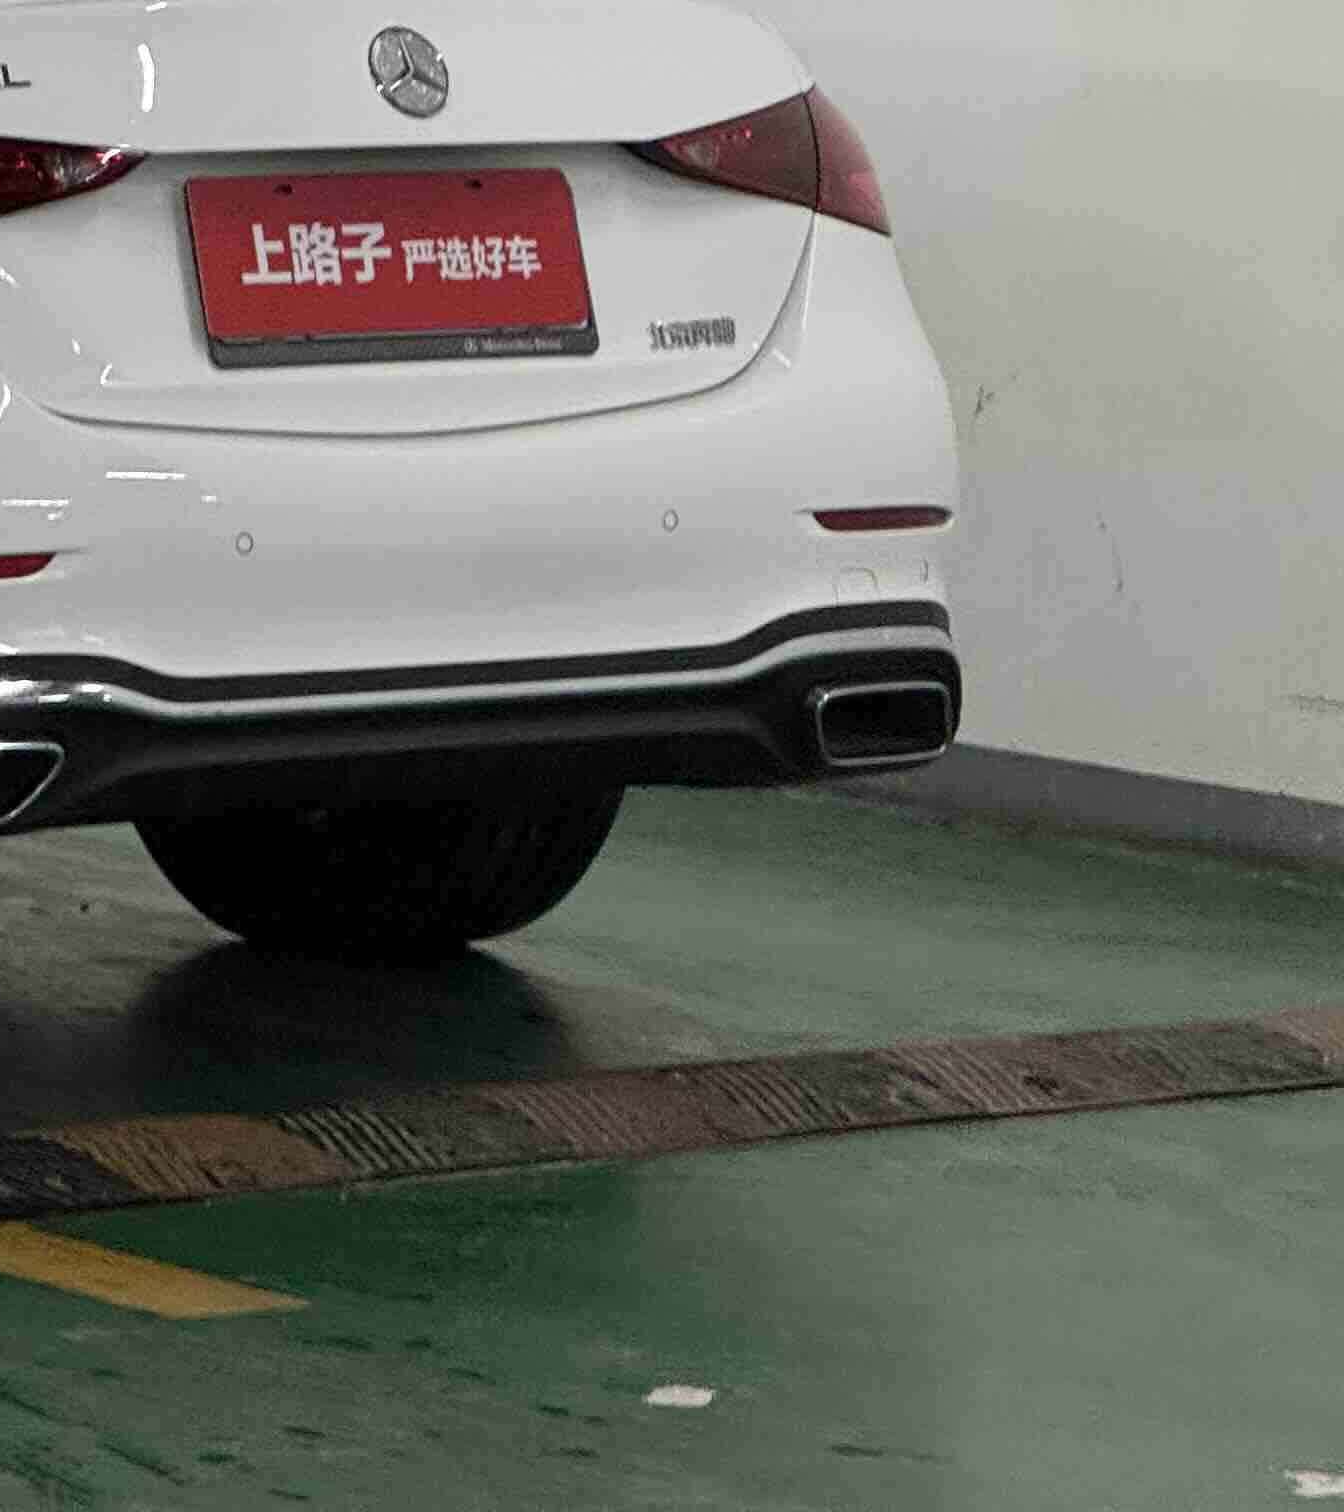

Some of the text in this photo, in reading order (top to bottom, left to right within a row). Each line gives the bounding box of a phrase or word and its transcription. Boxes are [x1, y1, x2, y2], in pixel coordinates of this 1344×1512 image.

[0, 62, 32, 89] L
[241, 221, 542, 286] 上路子 严选好车
